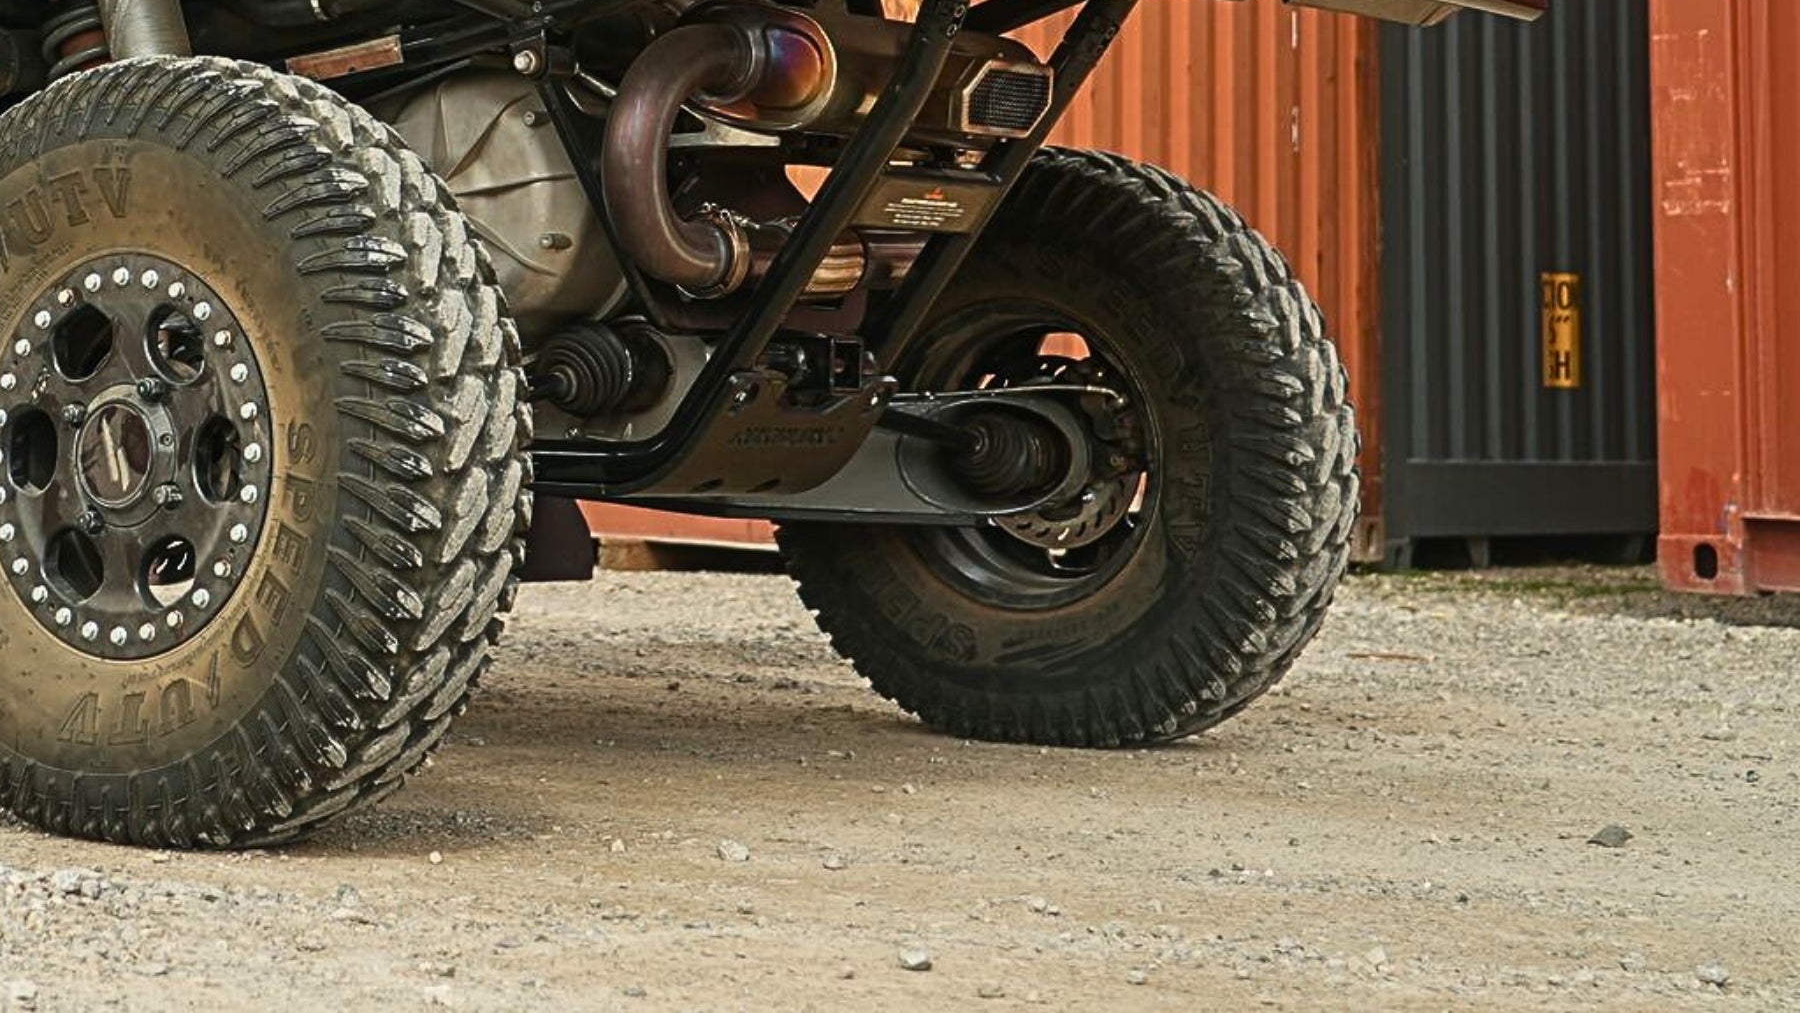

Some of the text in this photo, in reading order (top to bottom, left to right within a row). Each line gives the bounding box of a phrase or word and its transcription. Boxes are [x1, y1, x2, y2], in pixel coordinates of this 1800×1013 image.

[5, 166, 132, 246] UTV
[231, 418, 315, 668] SPEED
[57, 678, 198, 747] UTV
